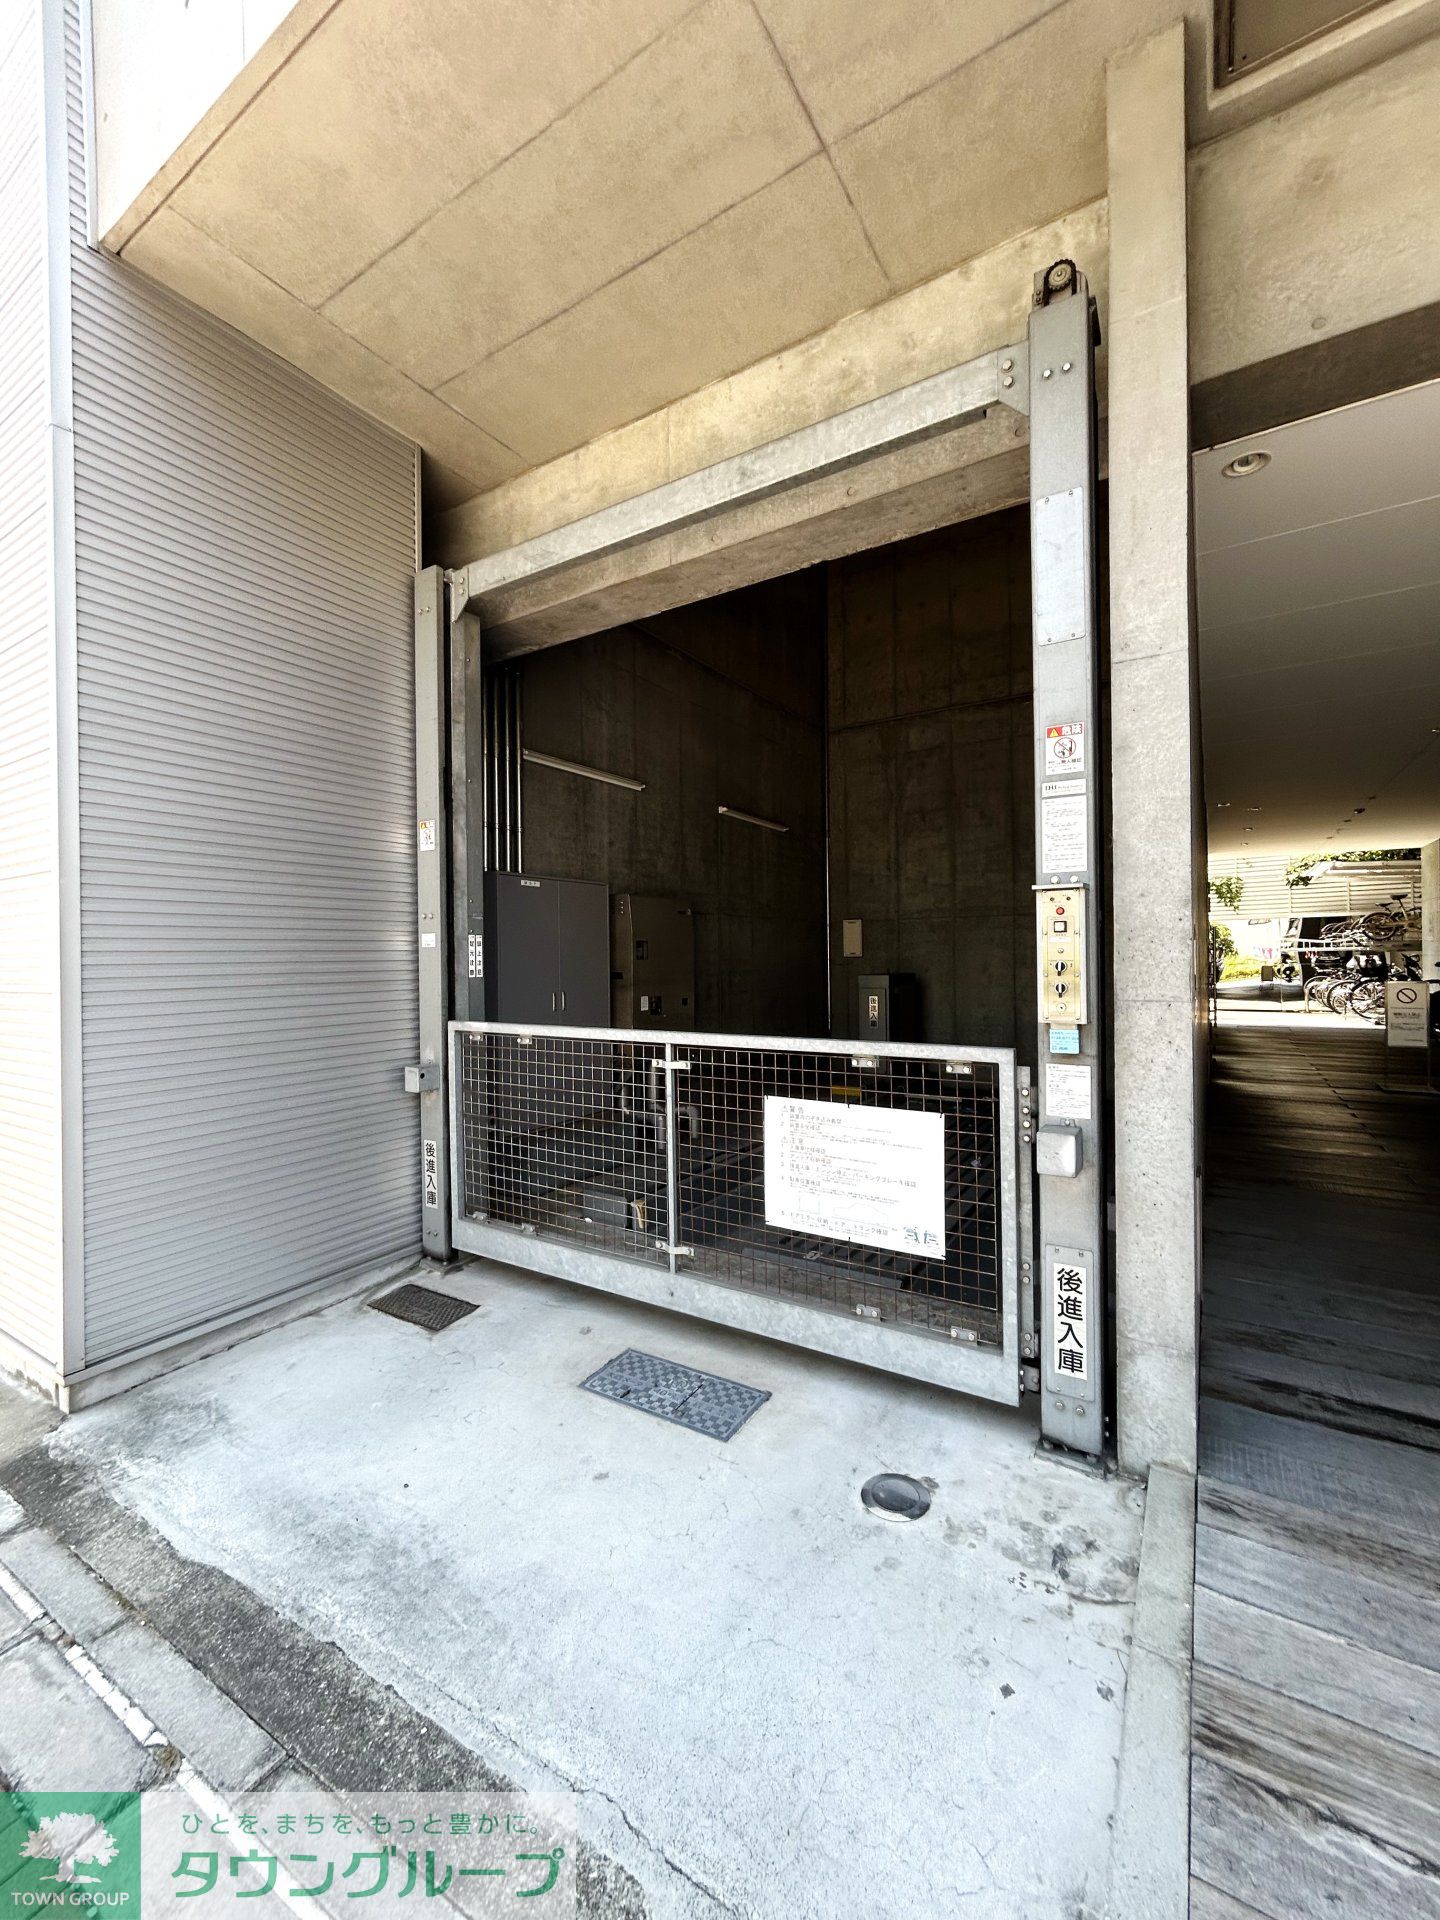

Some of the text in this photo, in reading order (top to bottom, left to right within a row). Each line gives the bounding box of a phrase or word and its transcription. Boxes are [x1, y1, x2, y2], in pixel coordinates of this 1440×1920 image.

[1061, 724, 1082, 736] 危険
[870, 997, 878, 1027] 後進入庫
[425, 1142, 437, 1206] 後進入庫
[1057, 1268, 1083, 1373] 後進入庫
